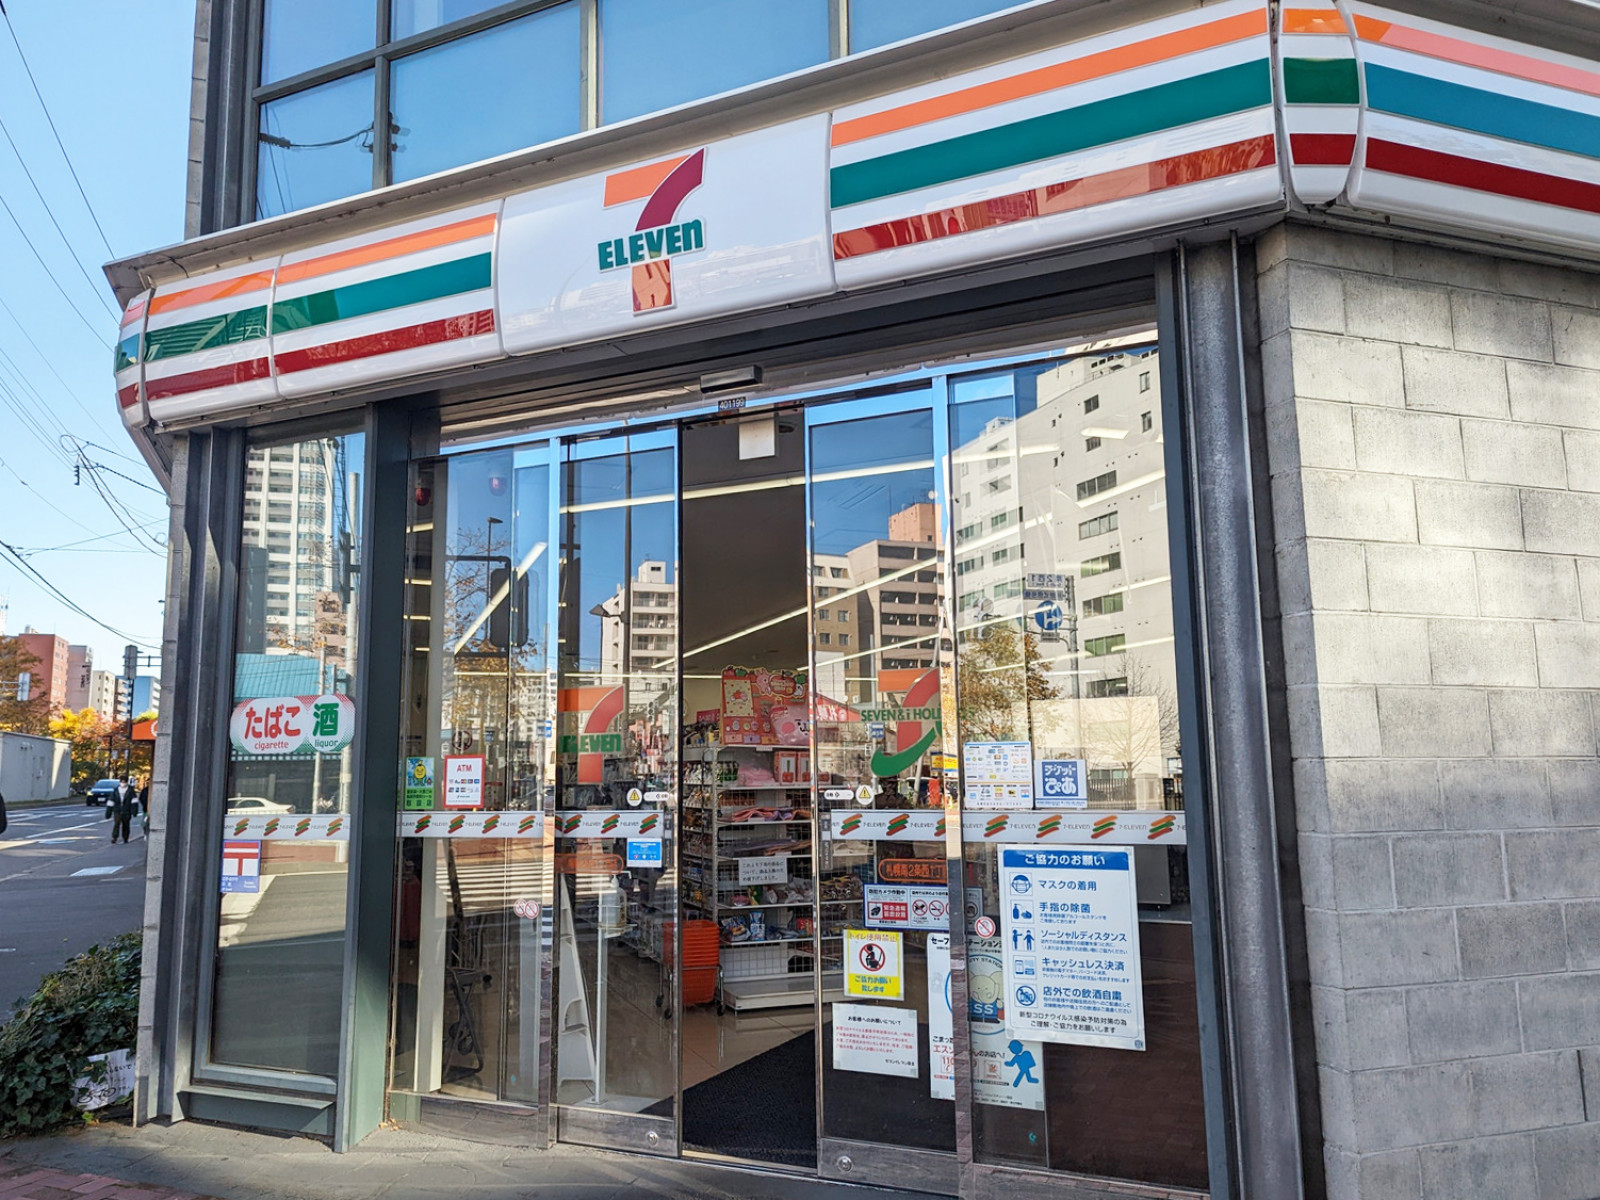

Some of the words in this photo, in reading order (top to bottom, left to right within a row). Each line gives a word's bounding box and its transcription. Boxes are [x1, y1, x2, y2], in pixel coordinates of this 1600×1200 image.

[244, 704, 301, 739] たばこ
[312, 703, 339, 736] 酒
[254, 740, 290, 751] cigarette
[314, 740, 339, 748] liquor
[457, 764, 472, 772] ATM
[1045, 764, 1077, 776] チケット
[1045, 777, 1077, 795] ぴあ
[1025, 854, 1105, 866] ご協力のお願い
[1038, 880, 1097, 891] マスクの着用
[1038, 902, 1090, 913] 手指の除菌
[849, 933, 896, 942] トイレ使用禁止
[1041, 929, 1127, 942] ソーシャルディスタンス
[1042, 957, 1125, 972] キャッシュレス決済
[1043, 986, 1122, 1001] 店外での飲酒自粛
[1019, 1011, 1127, 1026] 新型コロナウイルス感染予防対策の為
